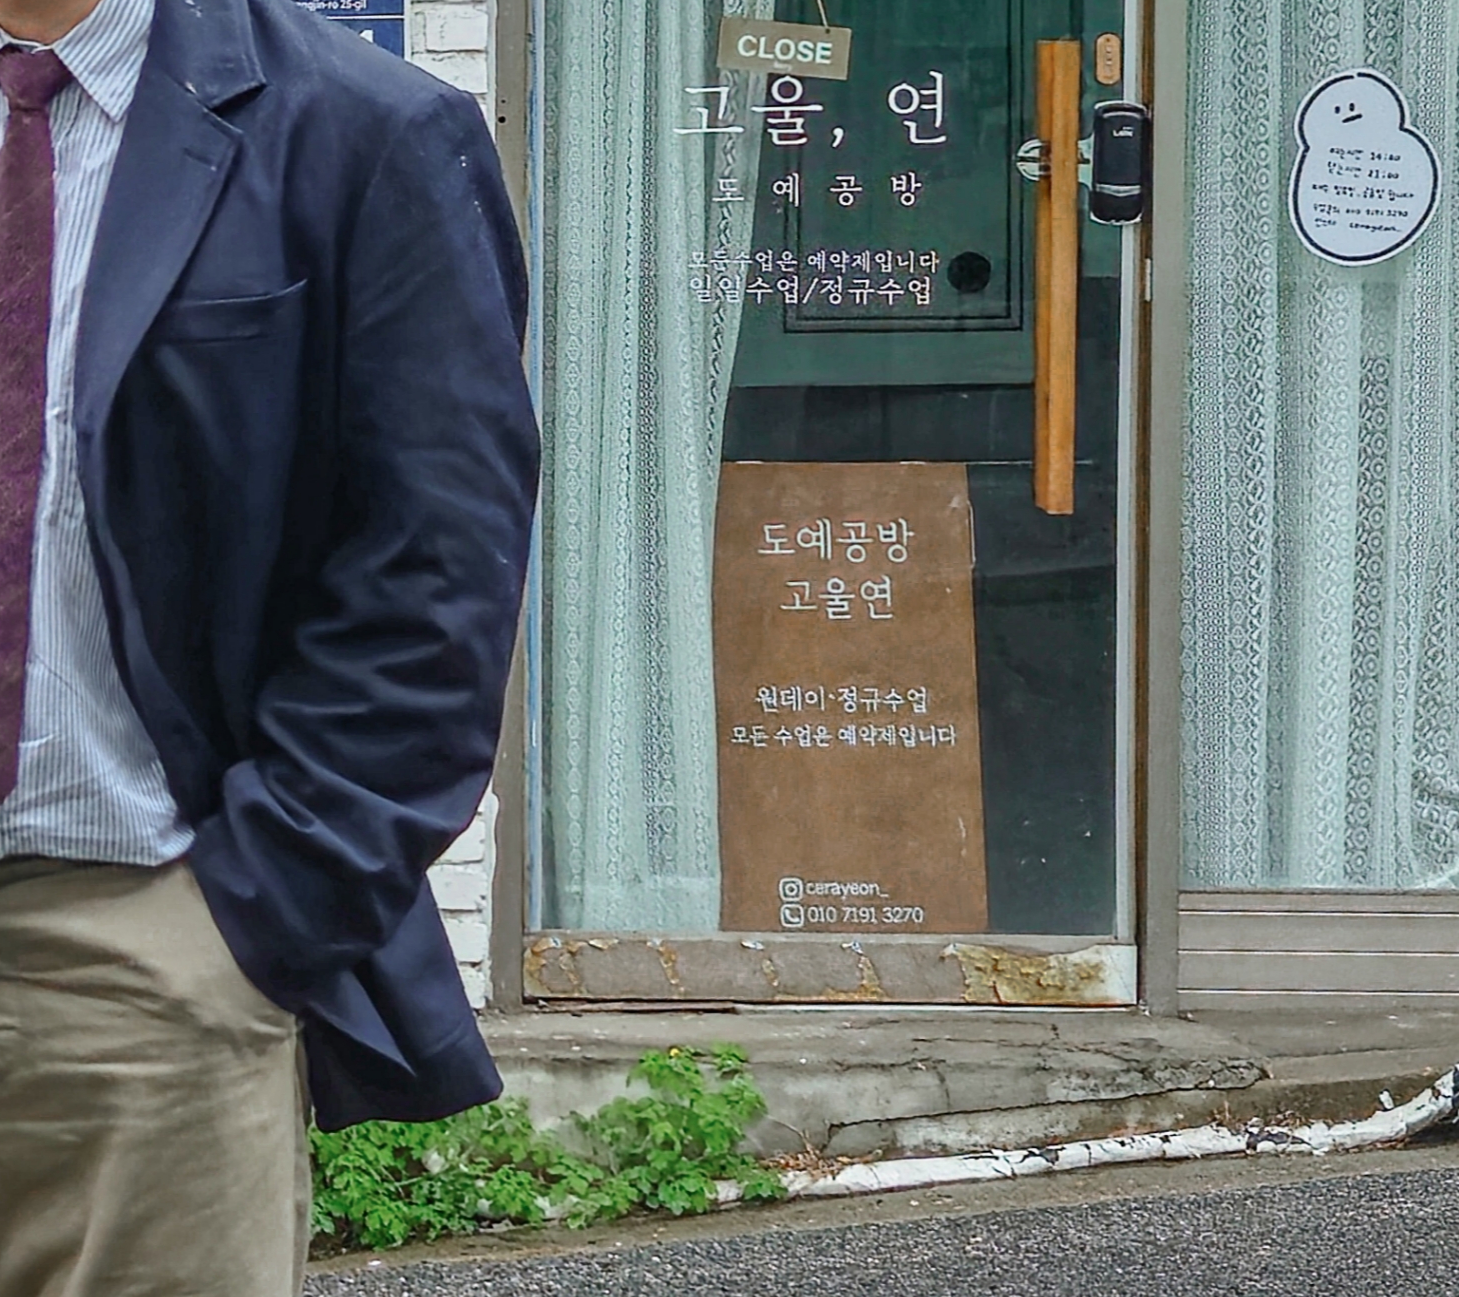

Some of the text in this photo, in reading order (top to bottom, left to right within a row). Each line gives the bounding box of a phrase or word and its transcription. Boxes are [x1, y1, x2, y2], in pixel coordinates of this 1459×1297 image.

[737, 35, 833, 64] CLOSE
[888, 70, 947, 144] 연
[807, 250, 940, 273] 예약제입니다
[757, 517, 916, 564] 도예공방
[780, 574, 893, 620] 고울연
[731, 724, 956, 748] 모든 수업은 예약제입니다
[807, 906, 837, 923] 010
[882, 906, 924, 923] 3270
